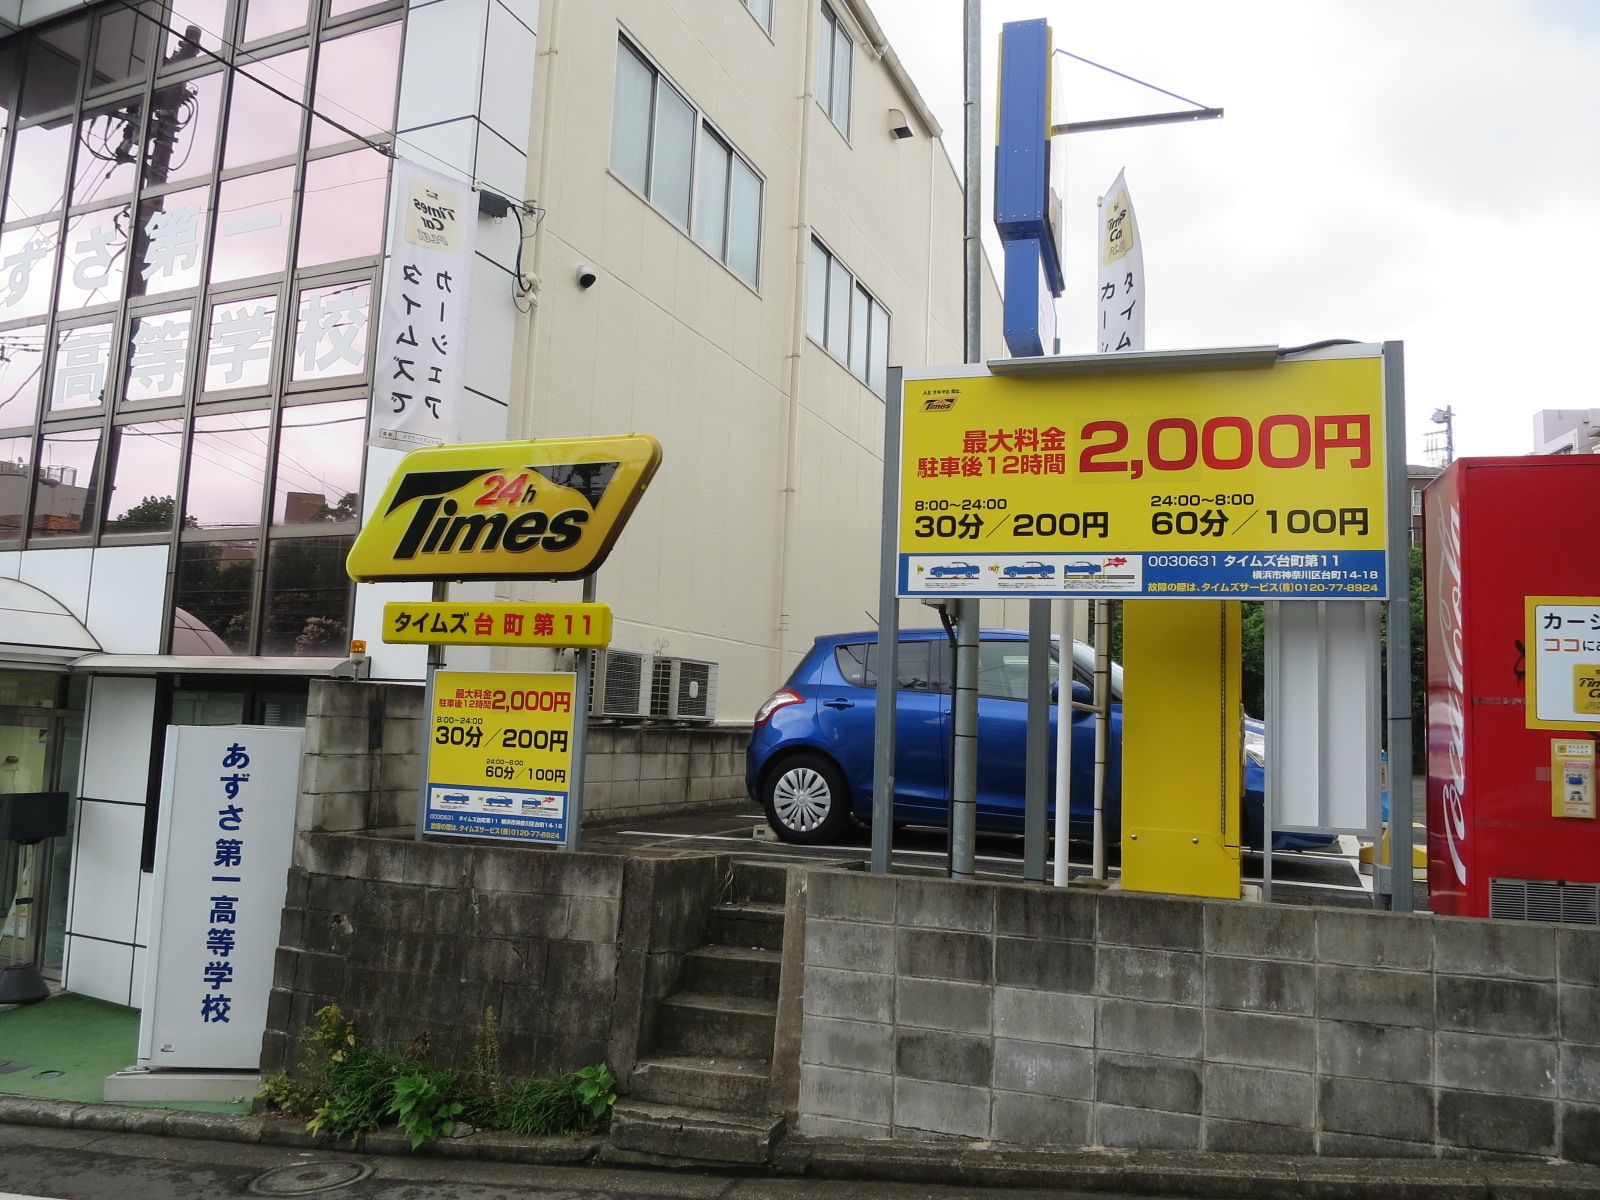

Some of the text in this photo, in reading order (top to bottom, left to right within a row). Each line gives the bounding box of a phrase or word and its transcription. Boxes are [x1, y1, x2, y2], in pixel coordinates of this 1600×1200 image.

[56, 293, 368, 402] 高等学校
[963, 426, 1066, 453] 最大料金
[1079, 414, 1371, 479] 2,000円
[917, 454, 1066, 478] 駐車後12時間
[475, 474, 537, 507] 24h
[393, 496, 589, 560] Times
[1148, 555, 1340, 568] 0030631 タイムズ台町第11
[1252, 570, 1378, 580] 横浜市神奈川区台町14-18
[439, 698, 493, 710] 駐車後12時間
[455, 688, 493, 700] 最大料金
[491, 689, 571, 713] 2,000円
[200, 742, 250, 1024] あずさ第一高等学校
